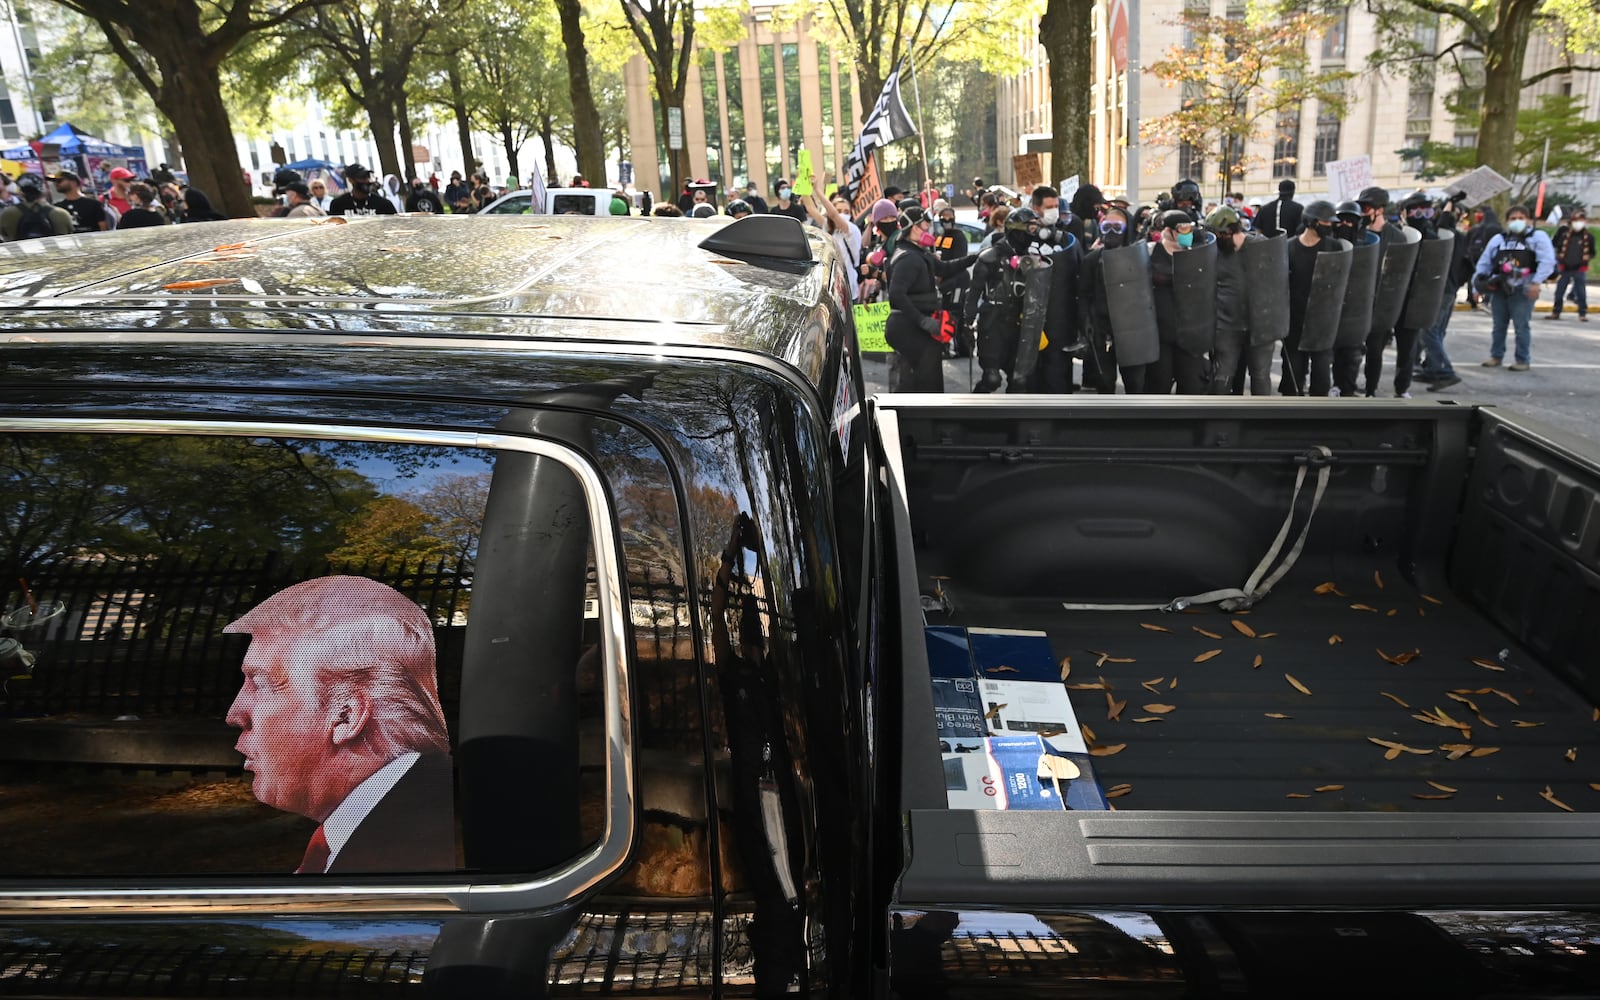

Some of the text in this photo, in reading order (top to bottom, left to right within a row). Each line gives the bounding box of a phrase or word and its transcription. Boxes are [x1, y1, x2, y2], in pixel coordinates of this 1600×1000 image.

[852, 185, 880, 216] NOW!
[935, 713, 981, 722] with Blu
[946, 721, 982, 732] Stereo
[1015, 772, 1028, 790] 1200
